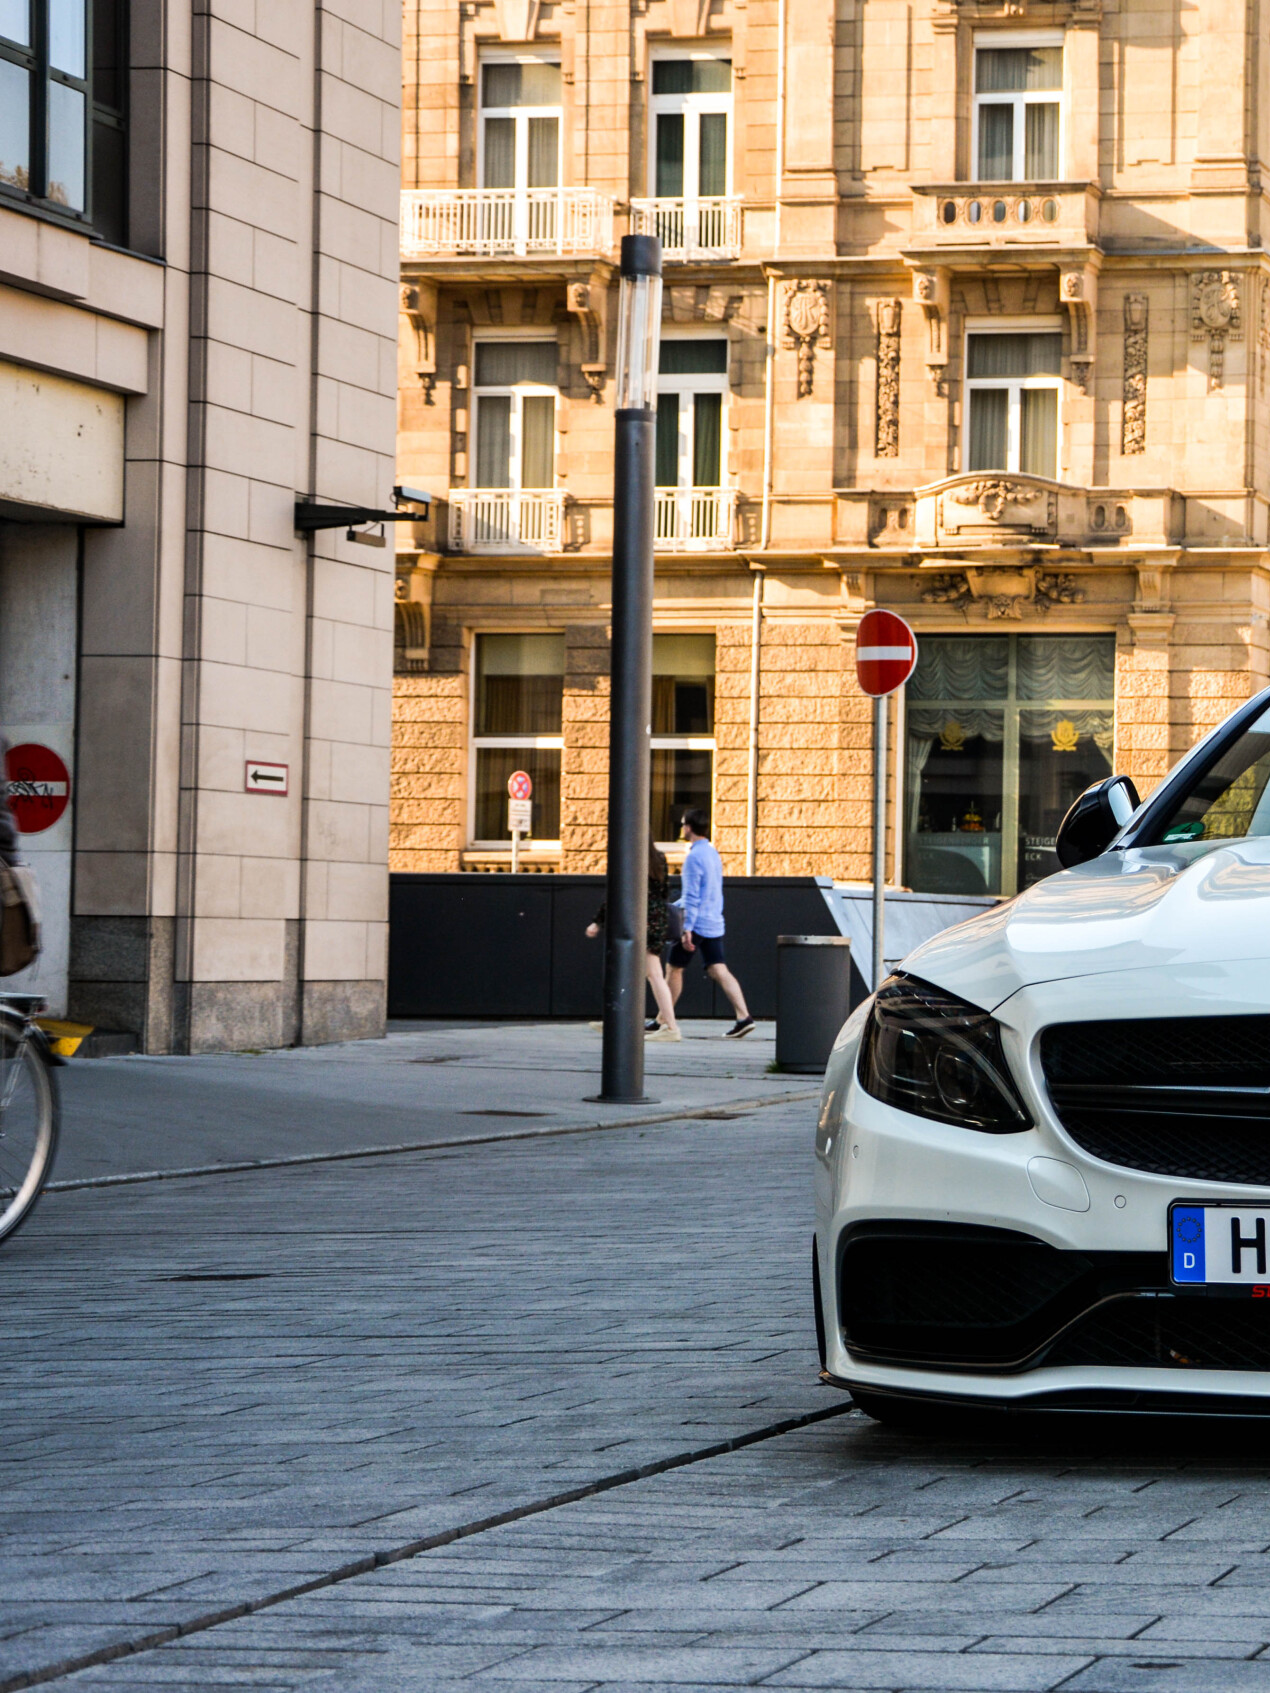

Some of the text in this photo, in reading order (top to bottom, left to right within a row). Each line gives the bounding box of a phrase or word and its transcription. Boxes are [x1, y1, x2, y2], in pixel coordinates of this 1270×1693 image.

[1180, 823, 1194, 833] 4
[1025, 836, 1057, 846] STEIGE
[1025, 852, 1042, 861] ECK
[1183, 1252, 1195, 1269] D
